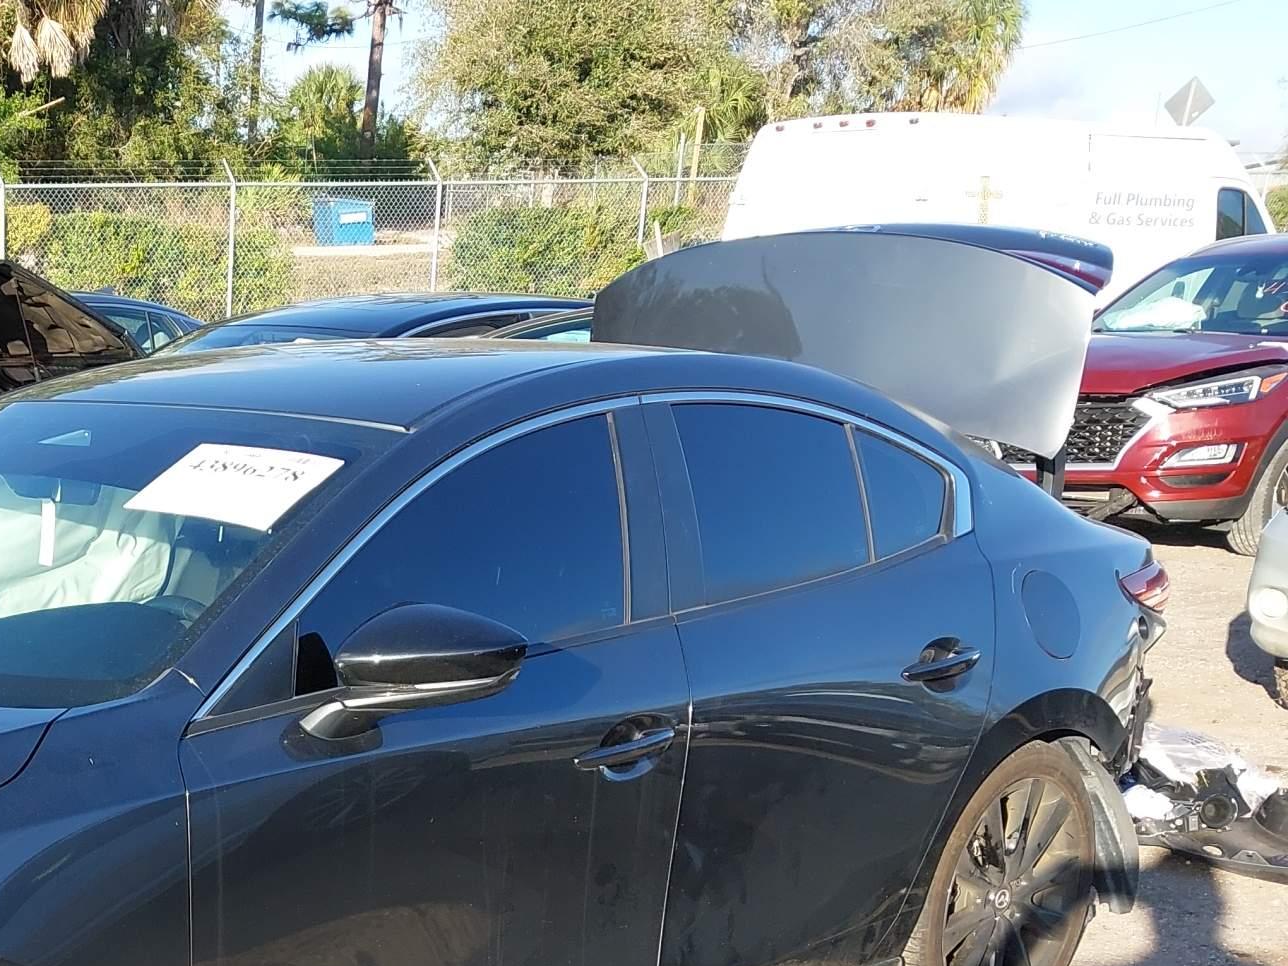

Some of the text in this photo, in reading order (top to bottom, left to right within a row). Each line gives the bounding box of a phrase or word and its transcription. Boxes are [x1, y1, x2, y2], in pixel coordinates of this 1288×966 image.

[1095, 191, 1195, 212] Full Plumbing
[1088, 211, 1195, 228] & Gas Services
